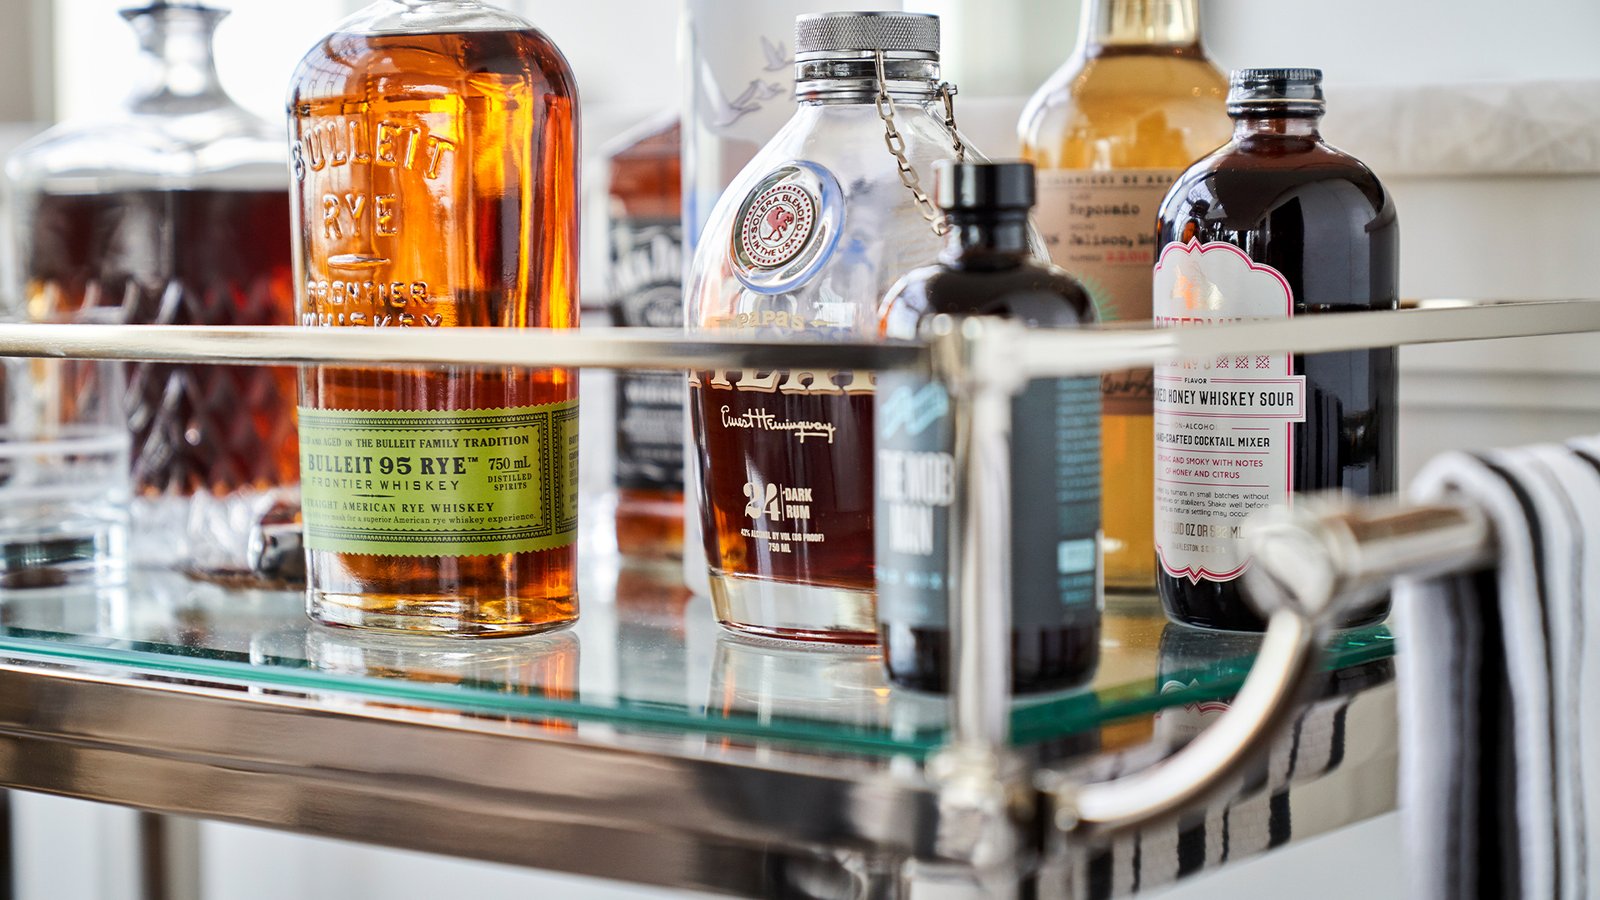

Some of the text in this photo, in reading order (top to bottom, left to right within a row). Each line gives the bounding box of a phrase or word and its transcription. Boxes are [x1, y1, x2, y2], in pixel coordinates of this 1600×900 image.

[292, 119, 456, 181] BULLEIT
[322, 193, 398, 239] RYE
[751, 196, 780, 233] SOLERA
[781, 194, 805, 231] BLENDED
[752, 238, 797, 257] IN THE USA
[307, 280, 430, 308] FRONTIER
[1168, 389, 1196, 405] HONEY
[1199, 390, 1255, 407] WHISKEY
[1260, 391, 1294, 407] SOUR
[323, 437, 342, 447] AGED
[356, 439, 373, 448] THE
[376, 439, 416, 449] BULLEIT
[420, 439, 459, 448] FAMILY
[463, 435, 529, 448] TRADITION
[1194, 435, 1235, 447] COCKTAIL
[1238, 437, 1270, 447] MIXER
[308, 454, 373, 475] BULLEIT
[380, 456, 412, 475] 95
[488, 455, 531, 470] 750 mL
[1186, 458, 1210, 466] SMOKY
[1236, 459, 1263, 467] NOTES
[487, 473, 533, 483] DISTILLED
[1194, 470, 1210, 478] AND
[1212, 471, 1240, 479] CITRUS
[312, 477, 459, 490] FRONTIER WHISKEY
[493, 482, 528, 491] SPIRITS
[743, 482, 781, 521] 24
[784, 487, 813, 502] DARK
[1214, 491, 1240, 499] batches
[343, 501, 396, 512] AMERICAN
[402, 503, 425, 513] RYE
[431, 502, 495, 513] WHISKEY
[1207, 500, 1227, 508] Shake
[1229, 500, 1243, 508] well
[1245, 500, 1269, 508] before
[785, 504, 811, 519] RUM
[1212, 510, 1228, 518] may
[363, 516, 392, 524] superior
[393, 516, 431, 524] American
[433, 517, 446, 525] rye
[449, 515, 485, 524] whiskey
[487, 513, 536, 524] experience.
[772, 531, 779, 540] BY
[780, 532, 791, 541] VOL
[1185, 523, 1195, 537] OZ
[1197, 524, 1208, 537] OR
[768, 542, 792, 553] 750 ML
